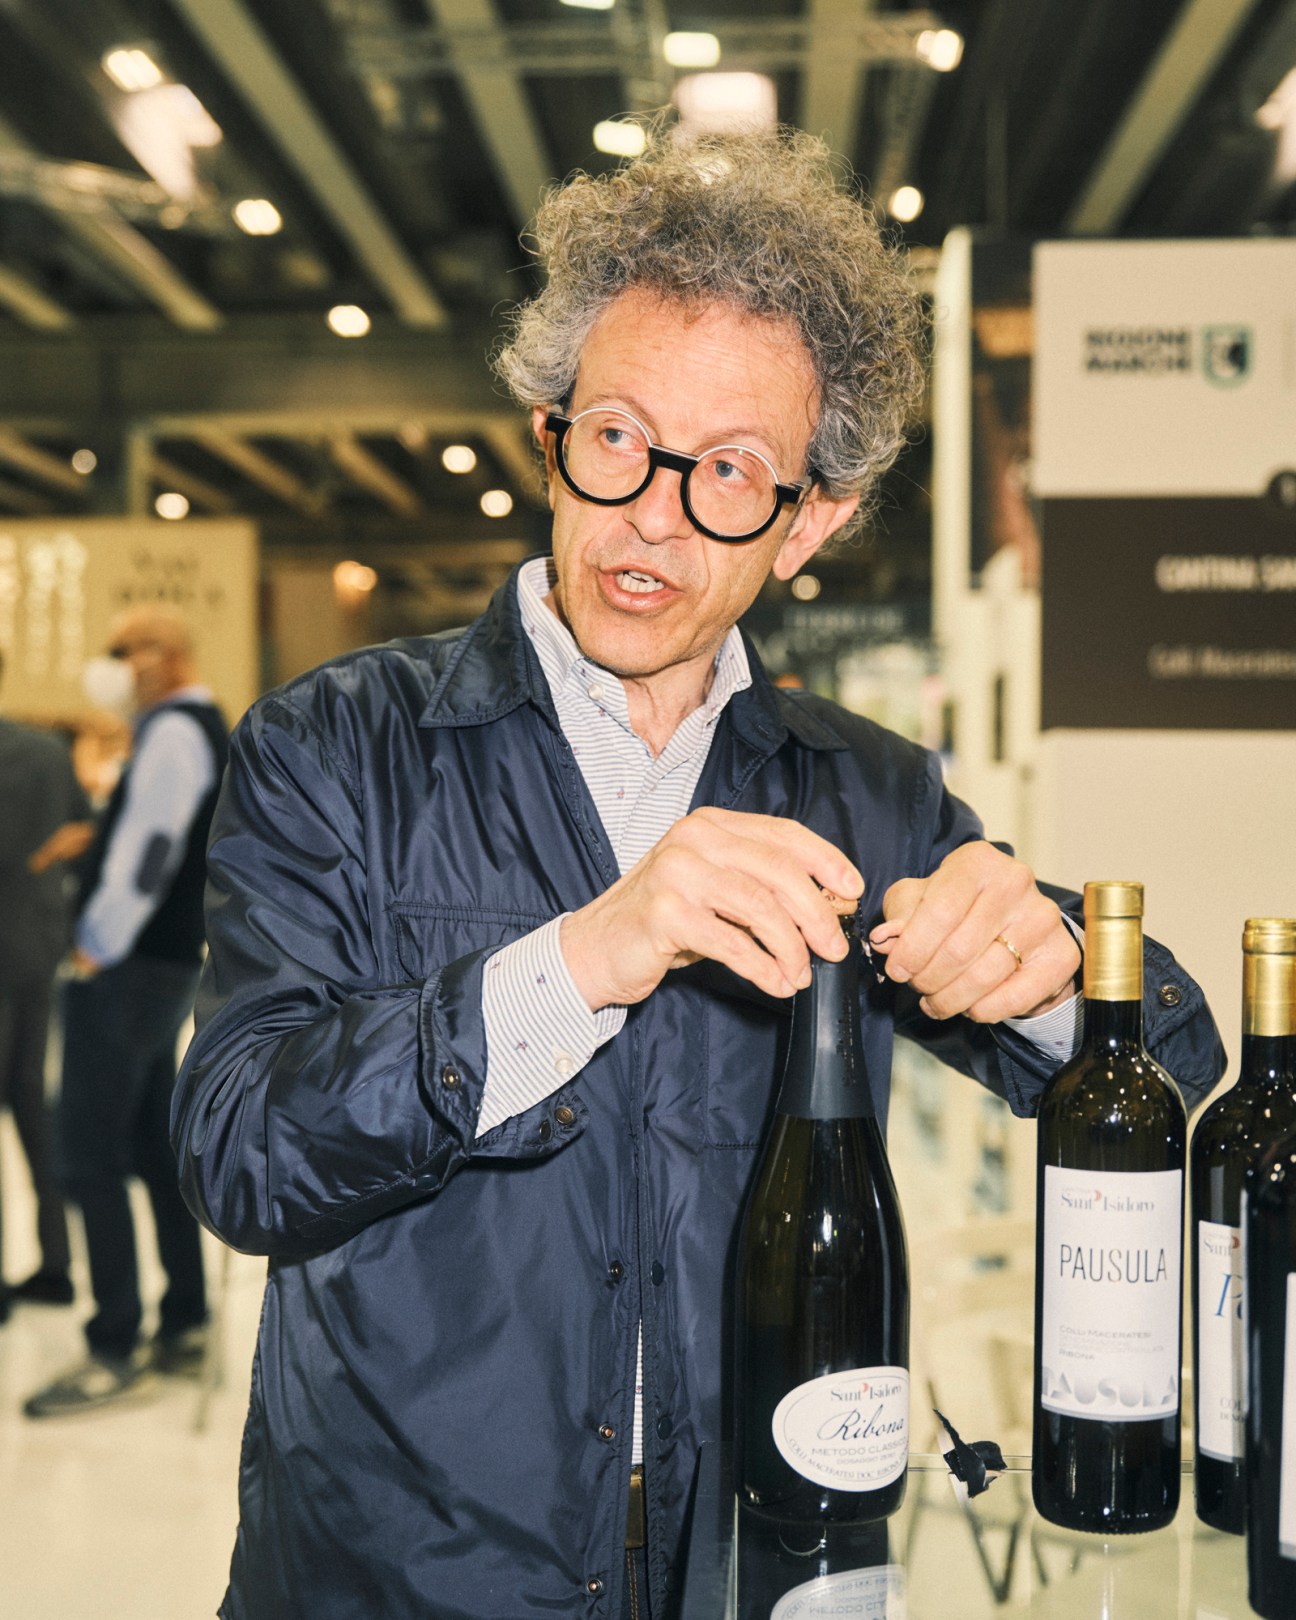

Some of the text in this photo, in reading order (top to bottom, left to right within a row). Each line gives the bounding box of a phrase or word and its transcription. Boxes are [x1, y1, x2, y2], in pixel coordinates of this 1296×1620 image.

[1060, 1243, 1168, 1284] PAUSULA
[1058, 1348, 1096, 1361] RIBONA
[817, 1403, 904, 1441] Ribona
[811, 1447, 867, 1457] METODO
